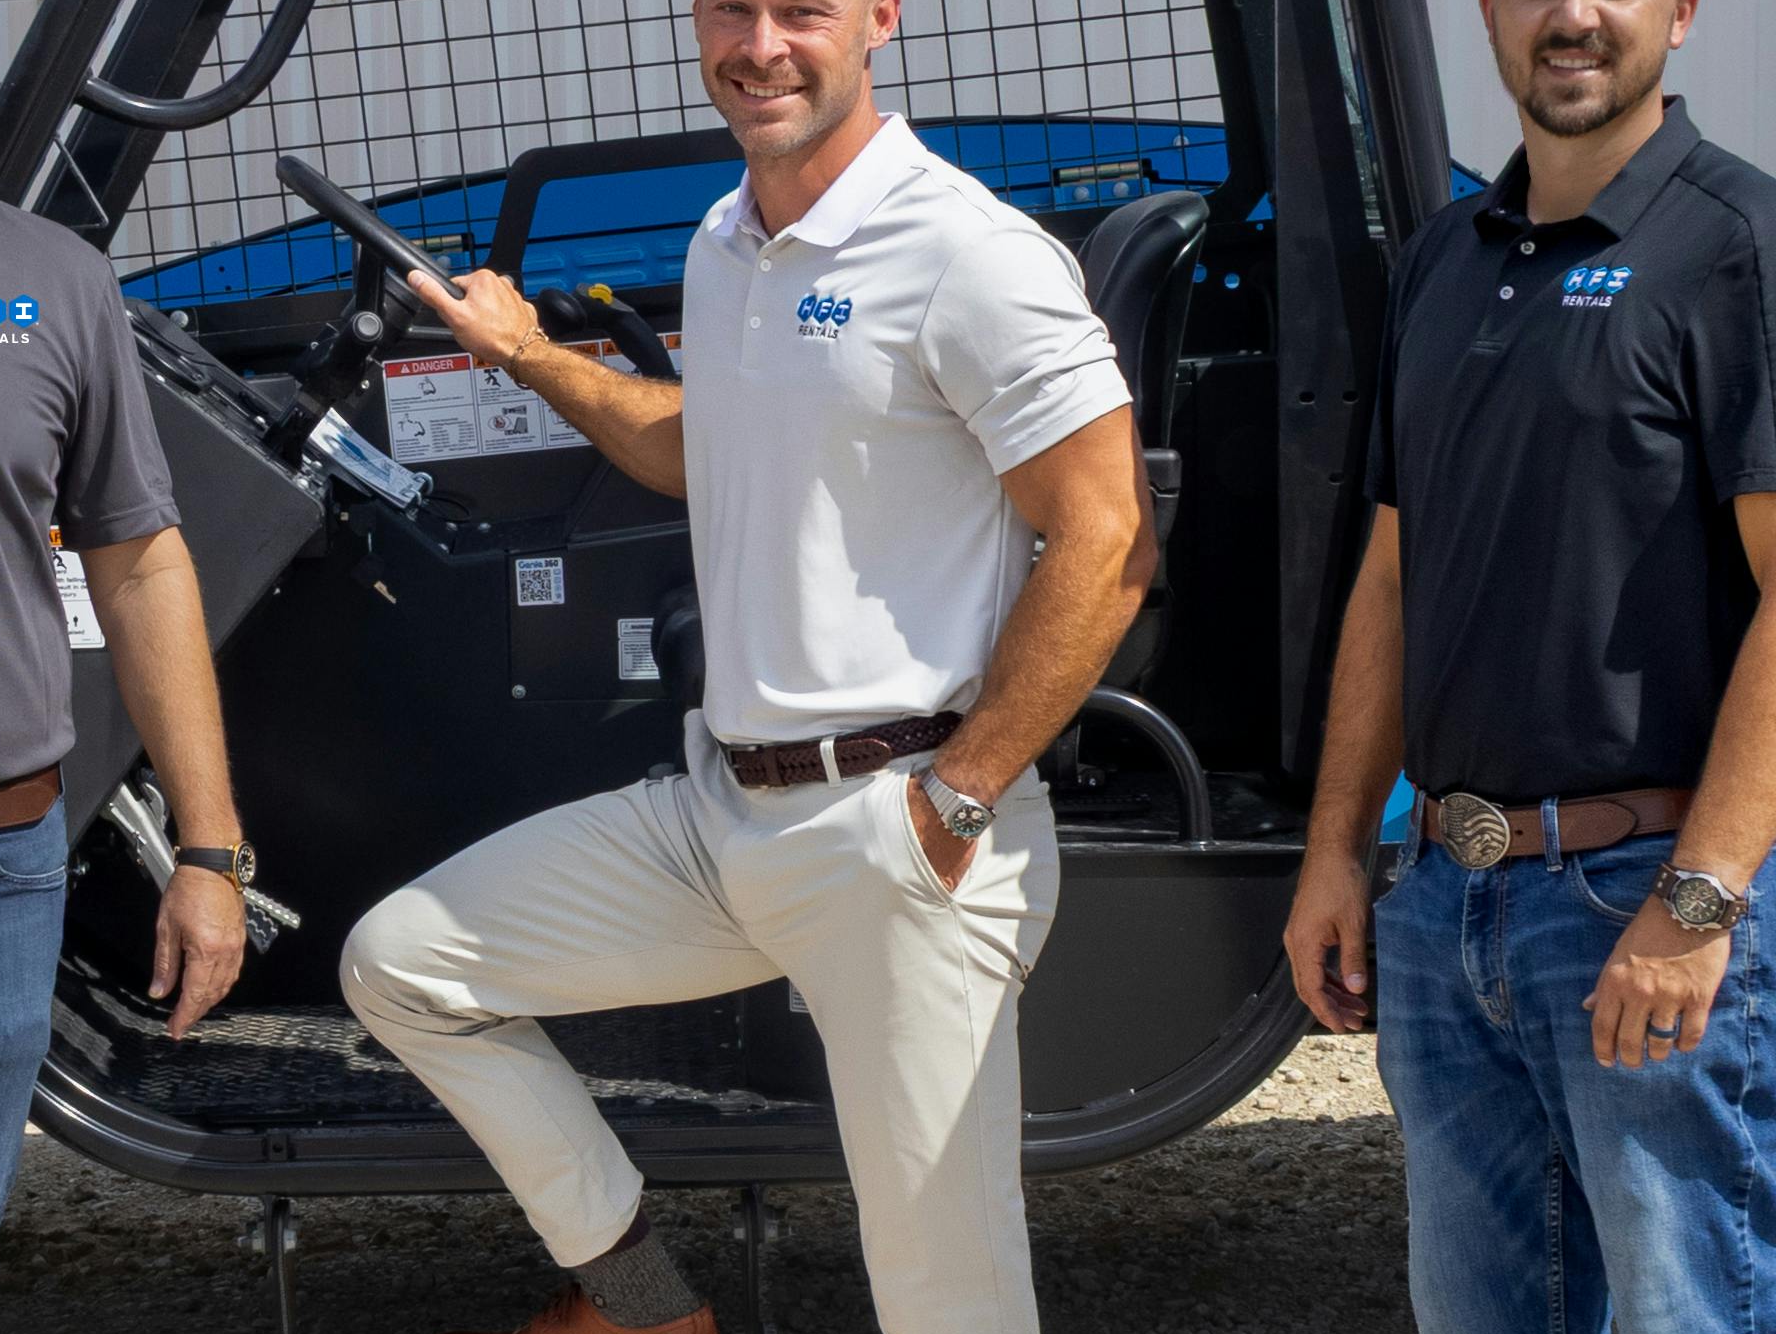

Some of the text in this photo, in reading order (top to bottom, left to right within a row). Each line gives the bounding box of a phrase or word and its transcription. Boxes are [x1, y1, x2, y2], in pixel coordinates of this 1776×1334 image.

[1561, 294, 1614, 308] RENTALS
[797, 324, 840, 340] RENTALS
[412, 360, 455, 373] DANGER
